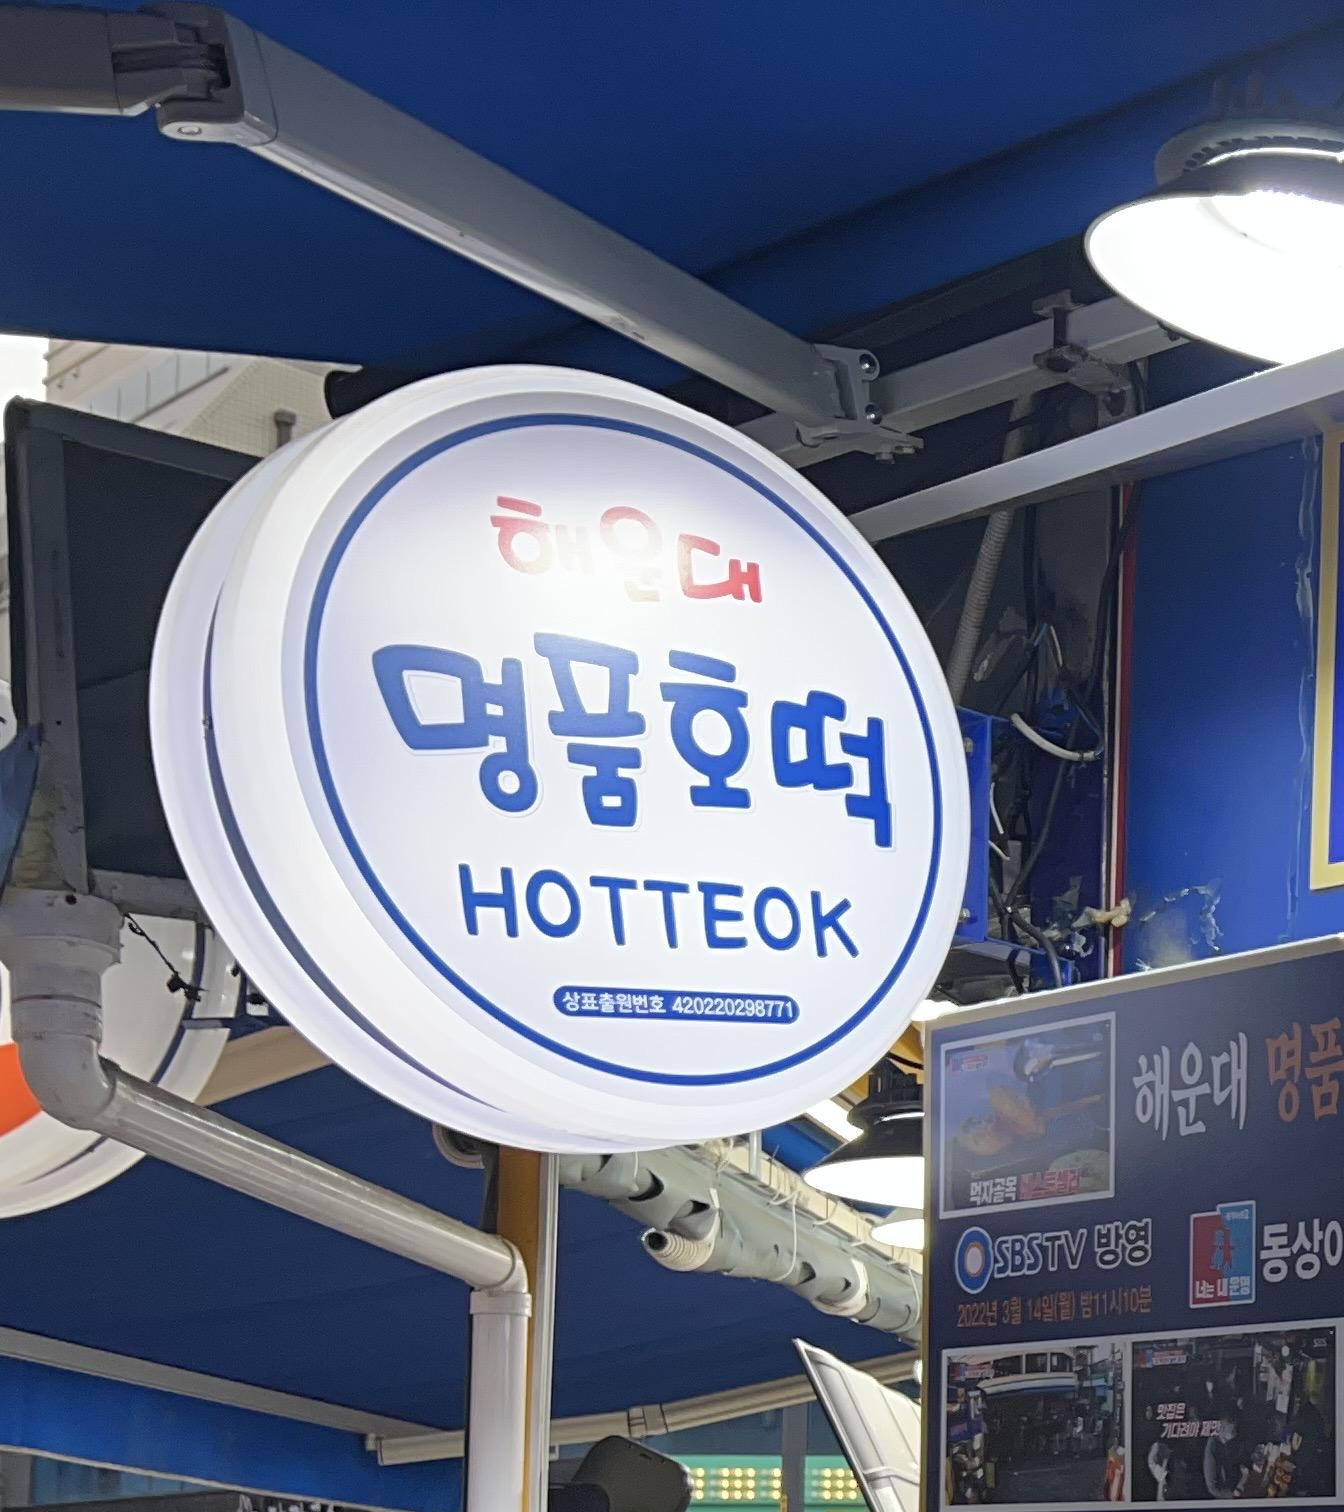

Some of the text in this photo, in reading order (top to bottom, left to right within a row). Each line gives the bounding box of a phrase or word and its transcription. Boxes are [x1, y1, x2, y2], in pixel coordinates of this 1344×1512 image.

[490, 494, 763, 604] 해운대
[371, 633, 894, 850] 명품호떡
[458, 863, 860, 959] HOTTEOK
[562, 991, 795, 1018] 상표출원번호 420220298771
[1132, 1032, 1248, 1140] 해운대
[1095, 1218, 1152, 1269] 방영
[957, 1303, 998, 1328] 2022년
[1002, 1296, 1023, 1325] 3월
